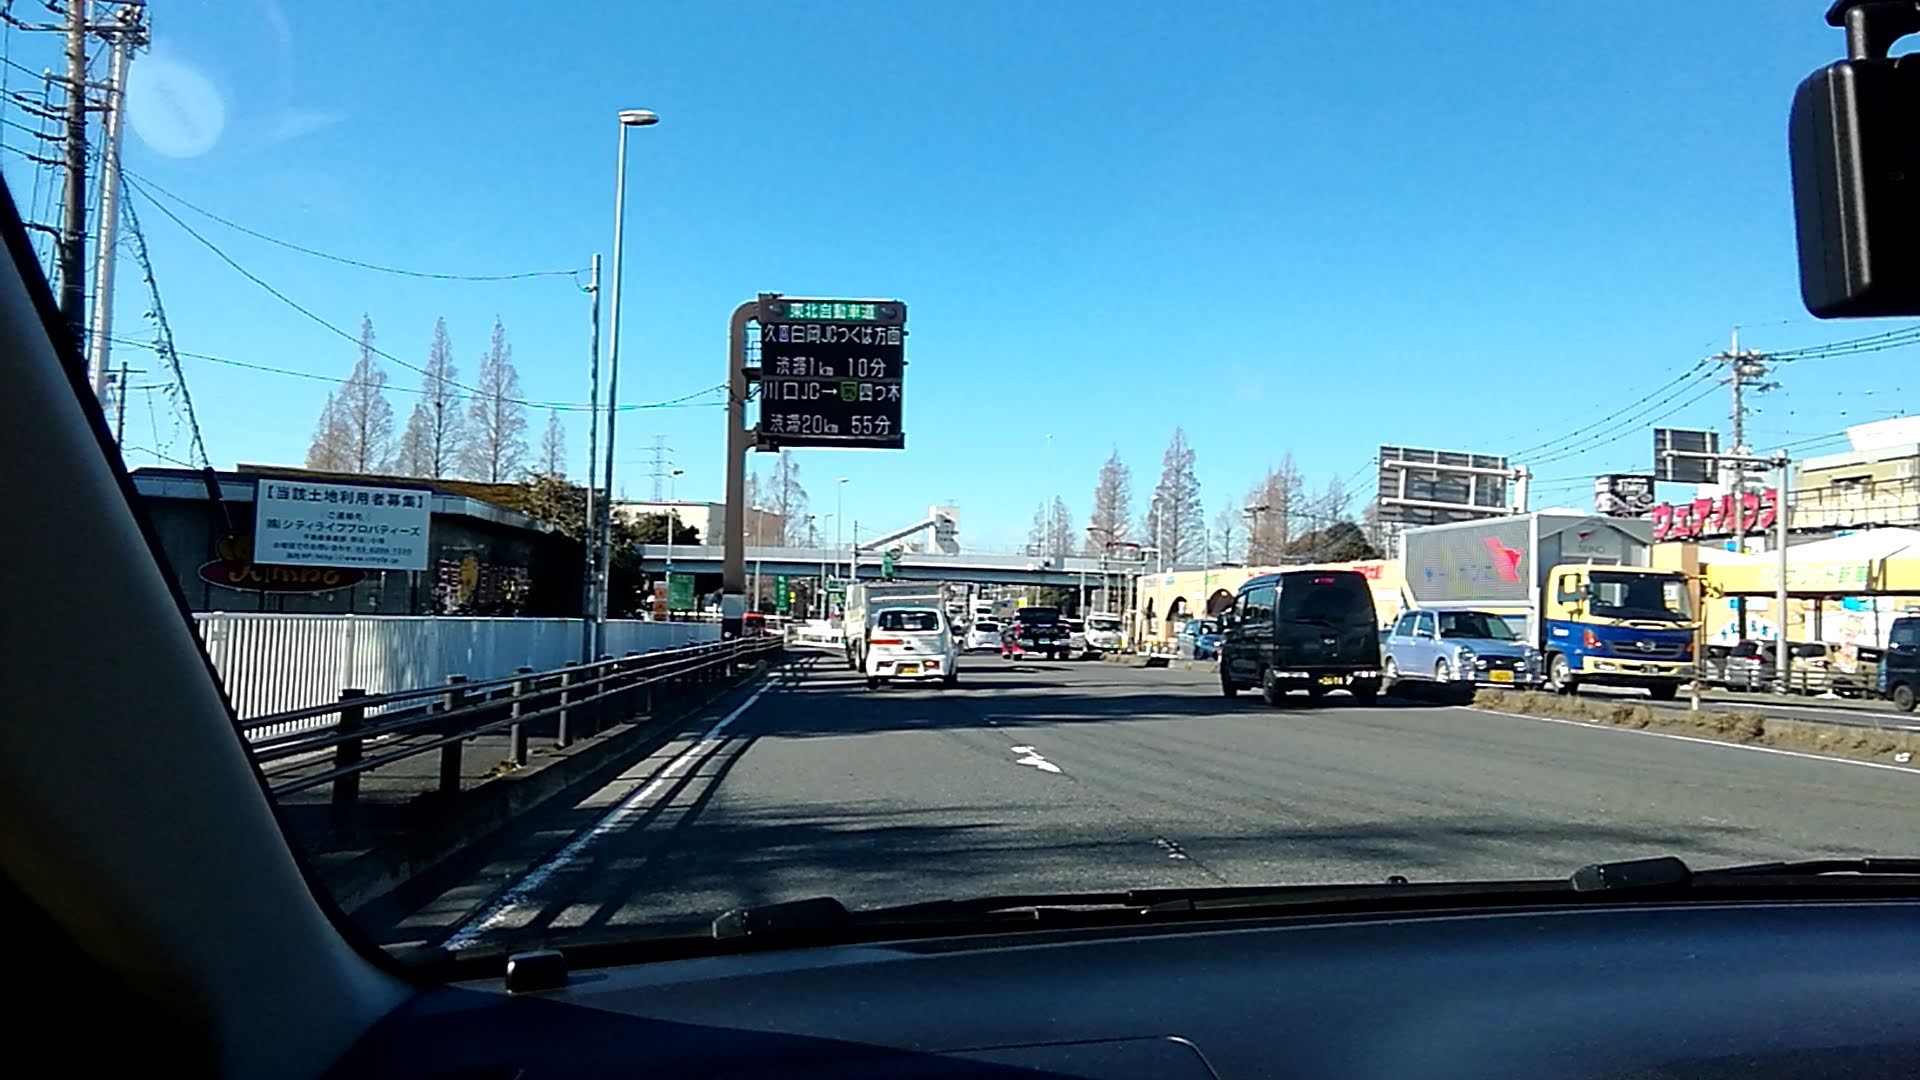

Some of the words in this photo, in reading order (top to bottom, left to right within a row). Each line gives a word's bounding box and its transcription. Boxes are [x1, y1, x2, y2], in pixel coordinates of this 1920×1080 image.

[789, 303, 876, 320] 東北自動車道
[848, 358, 887, 378] 10分
[851, 415, 892, 435] 55分
